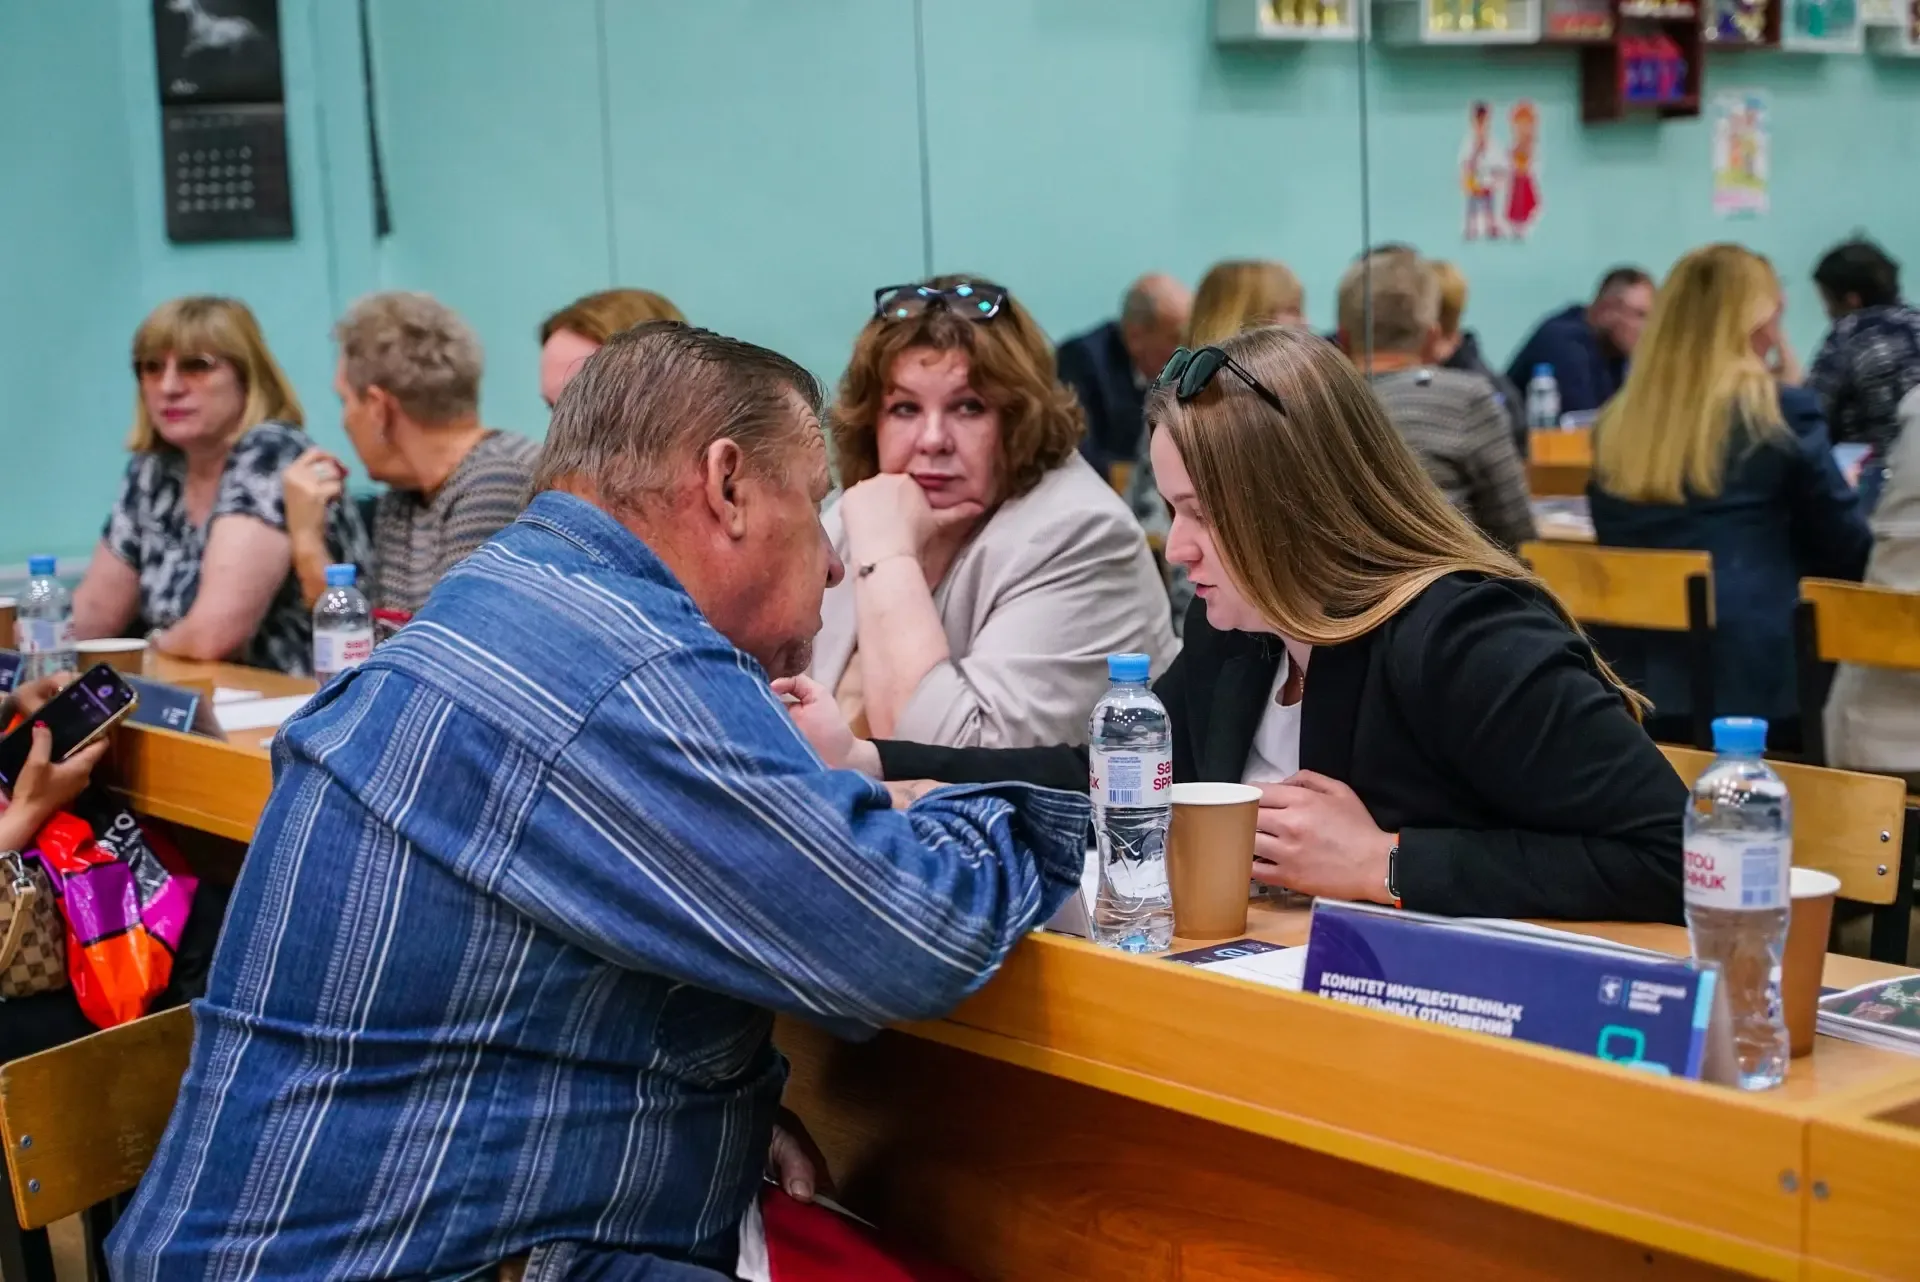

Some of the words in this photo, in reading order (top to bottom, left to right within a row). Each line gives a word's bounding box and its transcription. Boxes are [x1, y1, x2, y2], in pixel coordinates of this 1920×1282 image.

[1320, 971, 1386, 998] КОМИТЕТ
[1386, 983, 1524, 1022] ИМУЩЕСТВЕННЫХ
[1418, 1005, 1514, 1037] ОТНОШЕНИЙ
